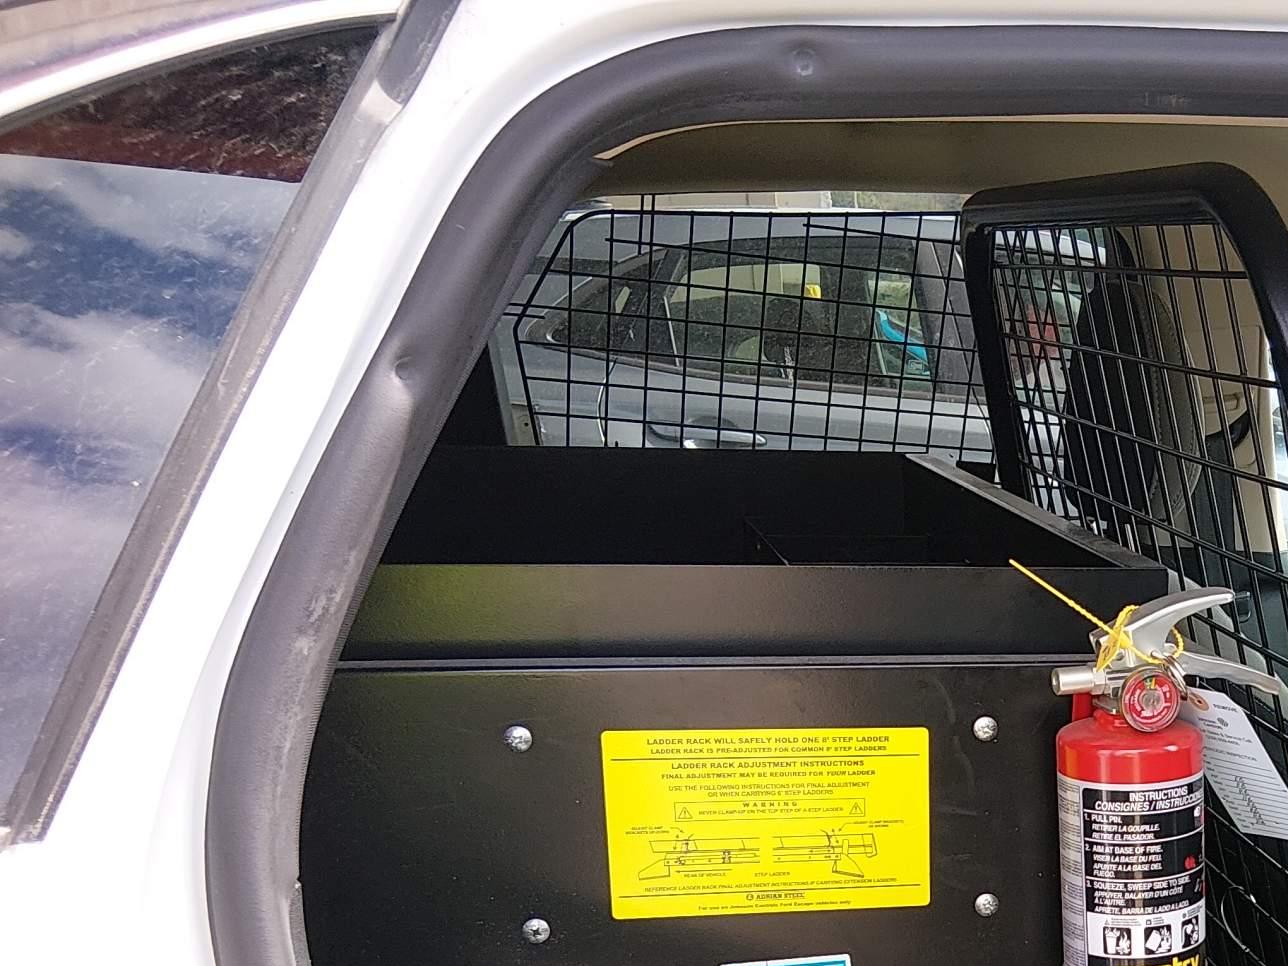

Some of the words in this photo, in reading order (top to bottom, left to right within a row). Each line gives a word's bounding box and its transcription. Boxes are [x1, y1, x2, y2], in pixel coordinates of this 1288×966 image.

[1129, 786, 1188, 801] INSTRUCTIONS
[1094, 800, 1150, 812] CONSIGNES
[1091, 814, 1108, 823] PULL
[1128, 824, 1160, 832] GOUPILLE.
[1123, 832, 1155, 840] PASADOR.
[1092, 845, 1105, 853] AIM
[1135, 846, 1145, 854] OF
[1146, 844, 1163, 853] FIRE.
[1093, 854, 1110, 862] VISER
[1093, 862, 1117, 871] APUNTE
[1124, 863, 1132, 871] LA
[1132, 863, 1150, 871] BASE
[1093, 870, 1115, 878] FUEGO.
[1093, 881, 1127, 891] SQUEEZE,
[1127, 881, 1152, 891] SWEEP
[1124, 891, 1153, 899] BALAYER
[1154, 889, 1169, 897] D'UN
[1100, 898, 1127, 906] L'AUTRE.
[1121, 907, 1145, 915] BARRA
[1145, 906, 1153, 914] DE
[1153, 903, 1170, 912] LADO
